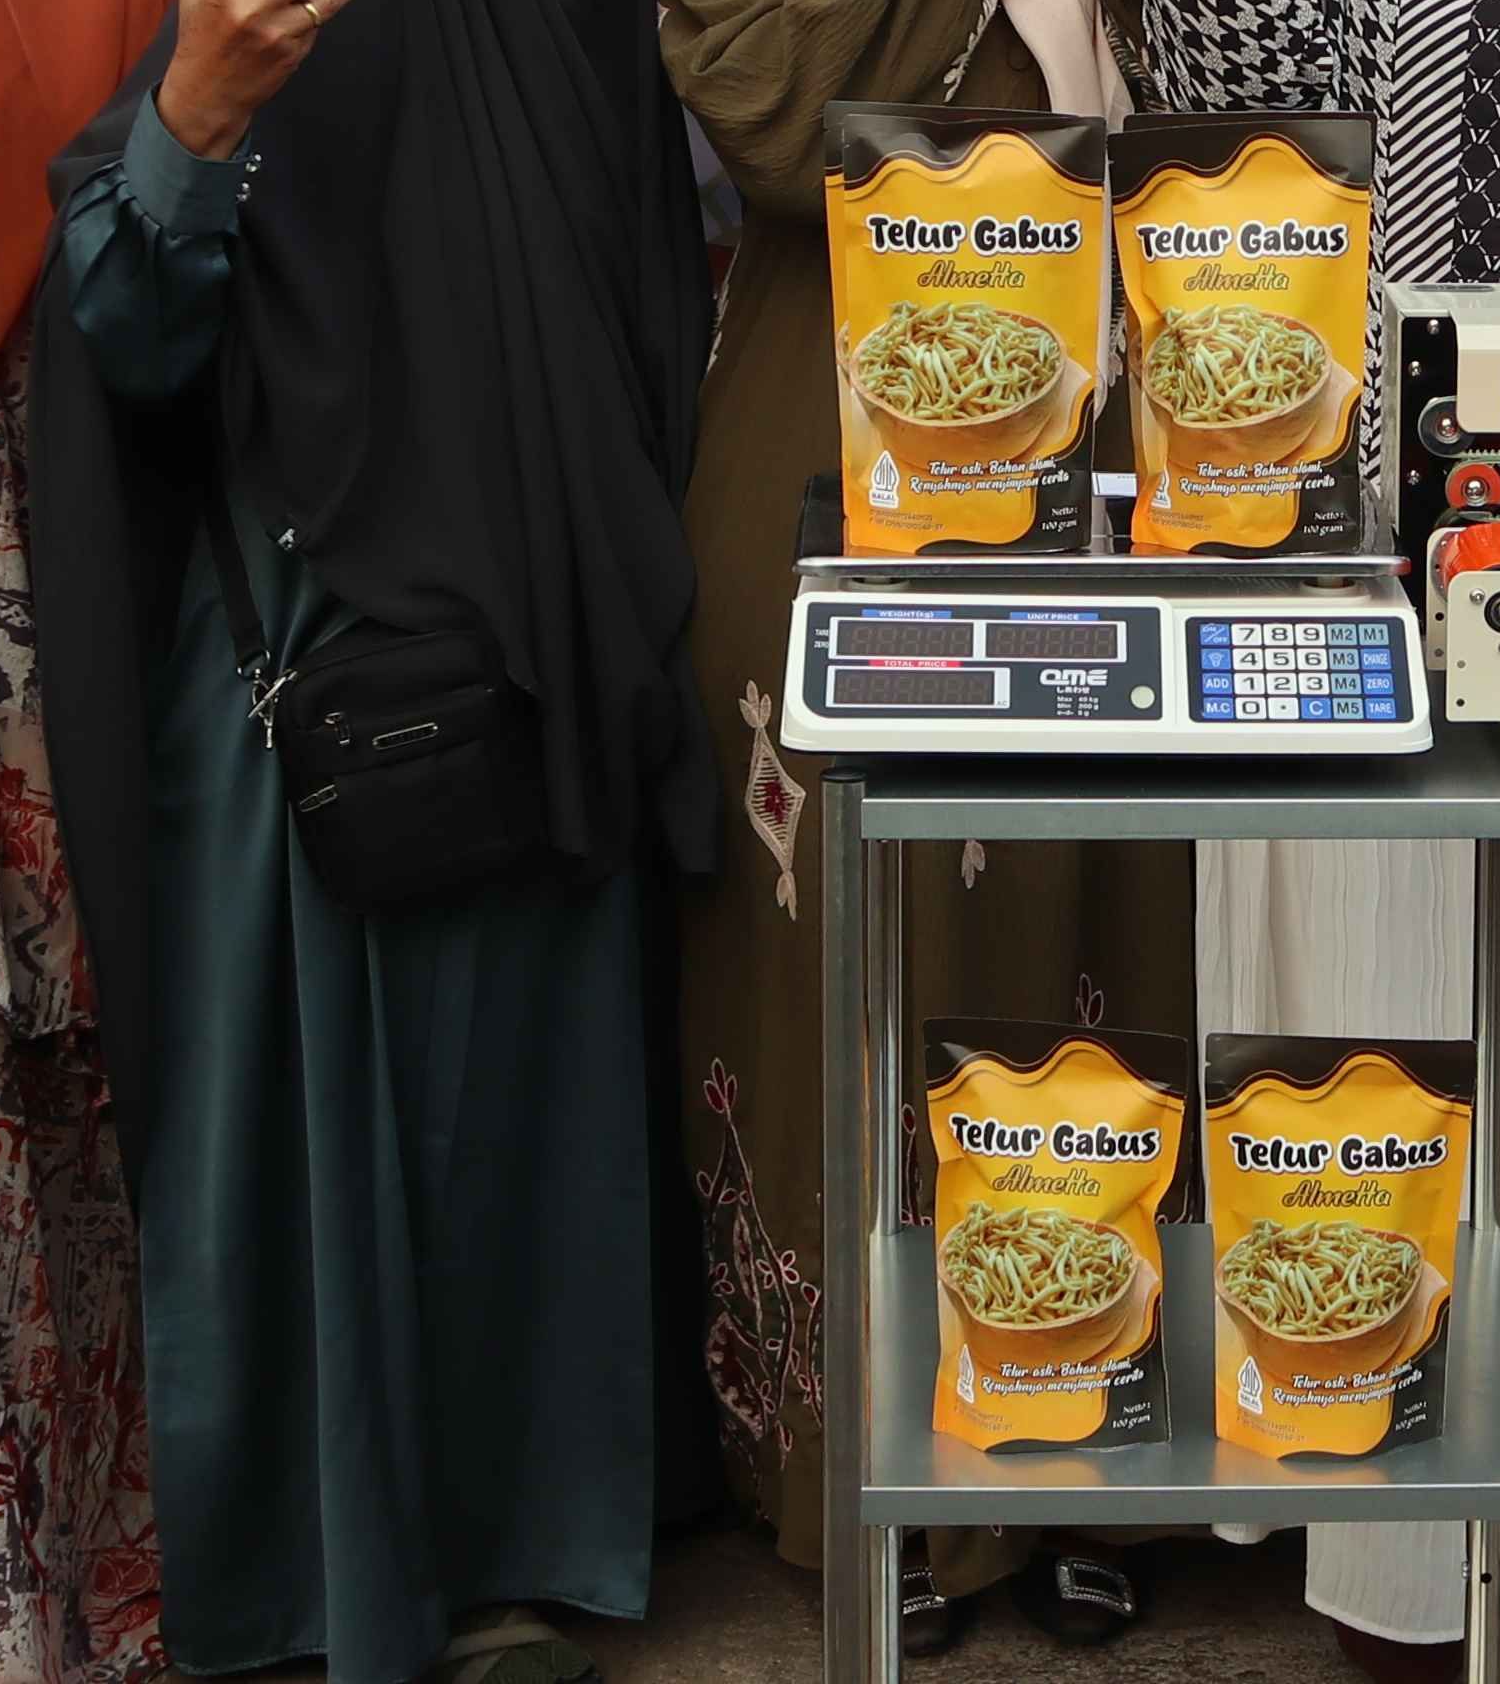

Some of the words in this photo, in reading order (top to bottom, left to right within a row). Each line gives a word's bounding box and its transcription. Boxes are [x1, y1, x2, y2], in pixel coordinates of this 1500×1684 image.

[867, 215, 964, 251] Telur
[972, 215, 1080, 254] Gabus
[1136, 222, 1231, 261] Telur
[1238, 220, 1347, 257] Gabus
[917, 259, 1026, 289] Almetta
[1183, 263, 1290, 292] Almetta
[928, 460, 958, 476] Telur
[989, 459, 1026, 475] Bahan
[1197, 462, 1223, 477] Telur
[1253, 462, 1289, 478] Bahan
[909, 476, 972, 496] Renyahnya
[975, 476, 1039, 494] menyimpan
[1041, 468, 1071, 486] cerita
[1179, 478, 1238, 498] Renyahnya
[1240, 479, 1302, 497] menyimpan
[1304, 473, 1336, 491] cerita
[1238, 628, 1256, 642] 7
[1271, 627, 1288, 642] 8
[1303, 627, 1321, 642] 9
[1331, 628, 1353, 641] M2
[1364, 628, 1384, 641] M1
[883, 660, 914, 668] TOTAL
[1240, 652, 1258, 666] 4
[1273, 652, 1290, 666] 5
[1305, 652, 1322, 666] 6
[1333, 653, 1356, 666] M3
[1205, 678, 1229, 689] ADD
[1243, 677, 1256, 690] 1
[1274, 677, 1291, 690] 2
[1306, 677, 1323, 690] 3
[1334, 678, 1358, 690] M4
[1366, 678, 1390, 689] ZERO
[1242, 701, 1260, 715] 0
[1309, 701, 1324, 715] C
[1336, 701, 1360, 714] M5
[1368, 702, 1392, 714] TARE
[949, 1114, 1044, 1155] Telur
[1051, 1122, 1160, 1161] Gabus
[1230, 1133, 1331, 1170] Telur
[1338, 1134, 1447, 1173] Gabus
[992, 1164, 1102, 1196] Almetta
[1281, 1179, 1393, 1208] Almetta
[980, 1377, 1044, 1396] Renyahnya
[1047, 1377, 1111, 1396] menyimpan
[1114, 1367, 1145, 1387] cerita
[1000, 1362, 1029, 1378] Telur
[1060, 1362, 1098, 1377] Bahan
[1292, 1374, 1321, 1390] Telur
[1352, 1370, 1387, 1388] Bahan
[1272, 1387, 1335, 1408] Renyahnya
